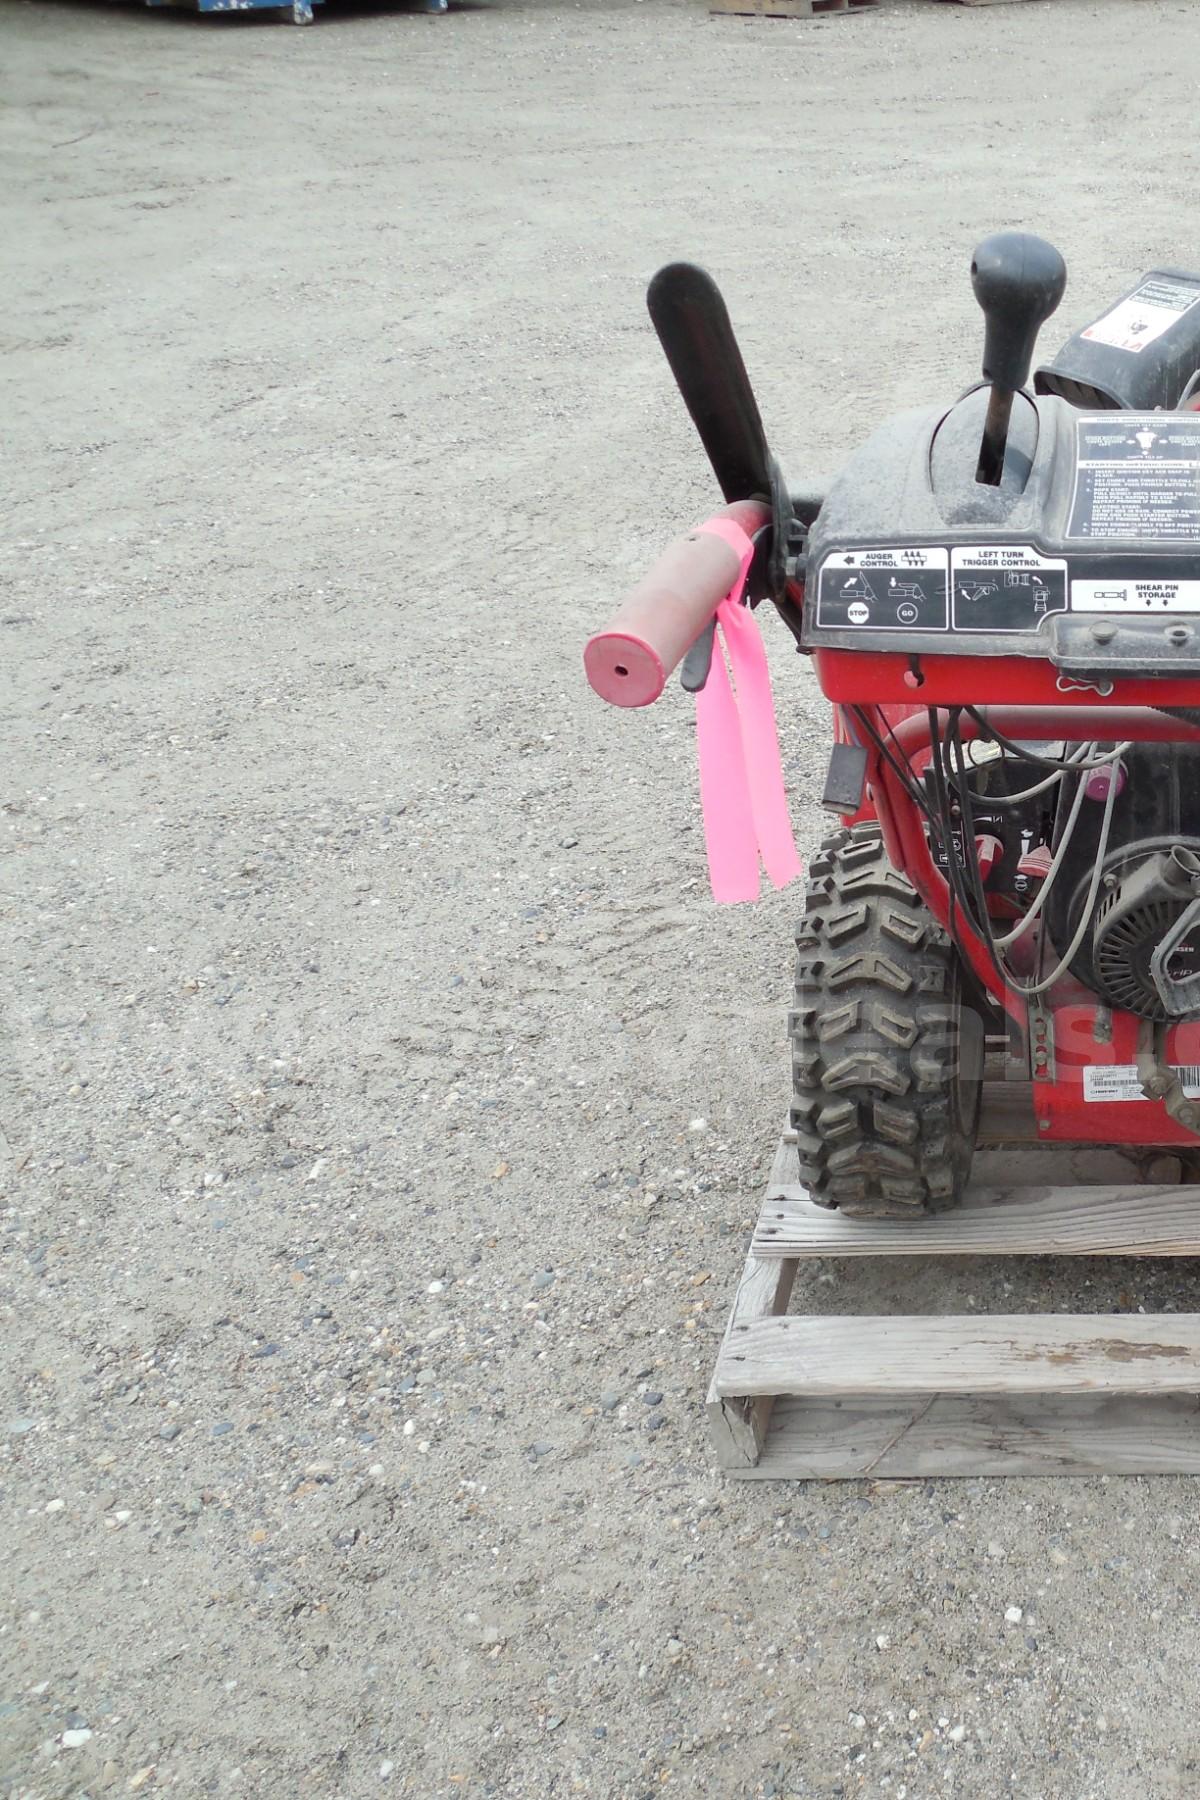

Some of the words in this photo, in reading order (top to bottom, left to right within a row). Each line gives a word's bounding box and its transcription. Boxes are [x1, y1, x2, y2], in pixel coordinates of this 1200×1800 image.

[962, 559, 999, 567] TRIGGER
[1000, 559, 1041, 567] CONTROL
[1138, 591, 1176, 599] STORAGE
